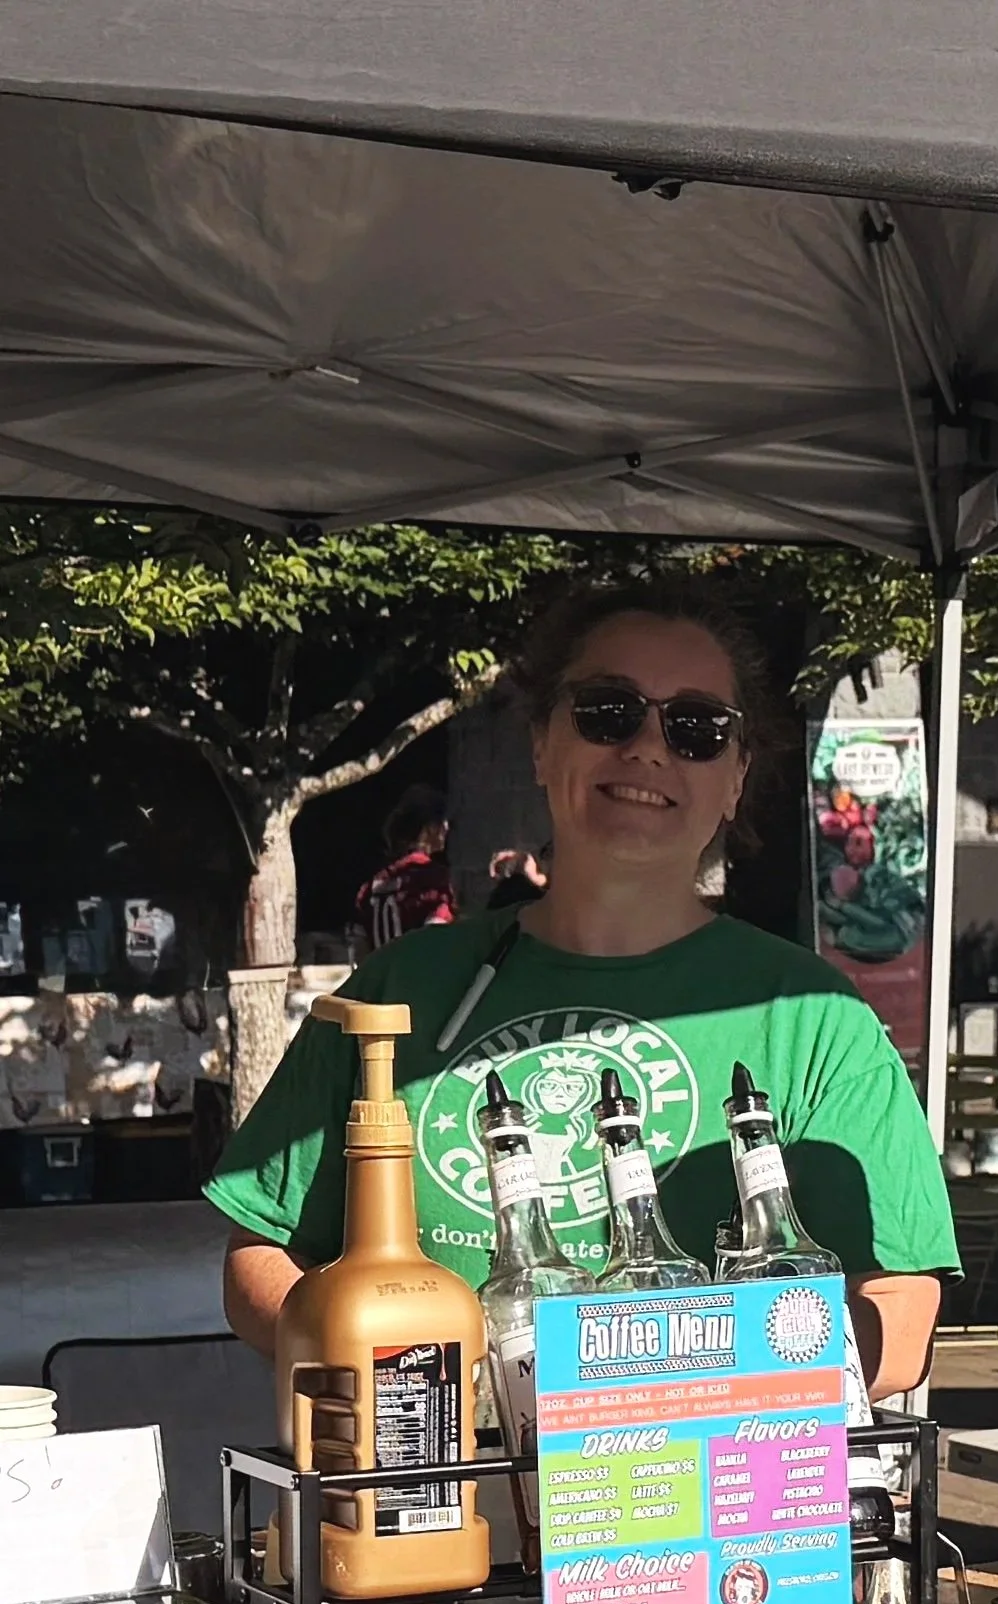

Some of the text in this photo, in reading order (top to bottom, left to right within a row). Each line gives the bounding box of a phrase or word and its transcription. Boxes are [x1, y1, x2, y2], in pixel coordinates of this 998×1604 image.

[453, 1013, 689, 1112] BUY LOCAL
[579, 1312, 735, 1364] Coffee Menu
[626, 1391, 651, 1403] ONLY
[665, 1387, 685, 1398] HOT
[690, 1386, 704, 1397] OR
[541, 1416, 557, 1427] WE
[588, 1409, 628, 1422] BURGER
[694, 1400, 731, 1412] ALWAYS
[735, 1397, 758, 1407] HAVE
[762, 1395, 770, 1404] IT
[776, 1393, 801, 1403] YOUR
[805, 1391, 825, 1401] WAY
[734, 1415, 820, 1444] Flavors
[580, 1426, 669, 1459] DRINKS
[715, 1452, 747, 1467] VANILLA
[780, 1445, 831, 1462] BLACKBERRY
[713, 1472, 751, 1487] CARAMEL
[786, 1465, 825, 1481] LAVENDER
[549, 1488, 603, 1506] AMERICANO
[631, 1484, 658, 1500] LATTE
[714, 1490, 755, 1506] HAZELNUT
[550, 1512, 571, 1527] DRIP
[631, 1503, 665, 1520] MOCHA
[717, 1511, 748, 1526] MOCHA
[771, 1501, 843, 1520] WHITE CHOCOLATE
[551, 1533, 574, 1548] COLD
[574, 1530, 602, 1545] BREW
[720, 1530, 838, 1558] Proudly Serving
[558, 1547, 696, 1586] Milk Choice
[598, 1585, 622, 1600] MILK
[622, 1583, 638, 1597] OR
[637, 1581, 657, 1596] OAT
